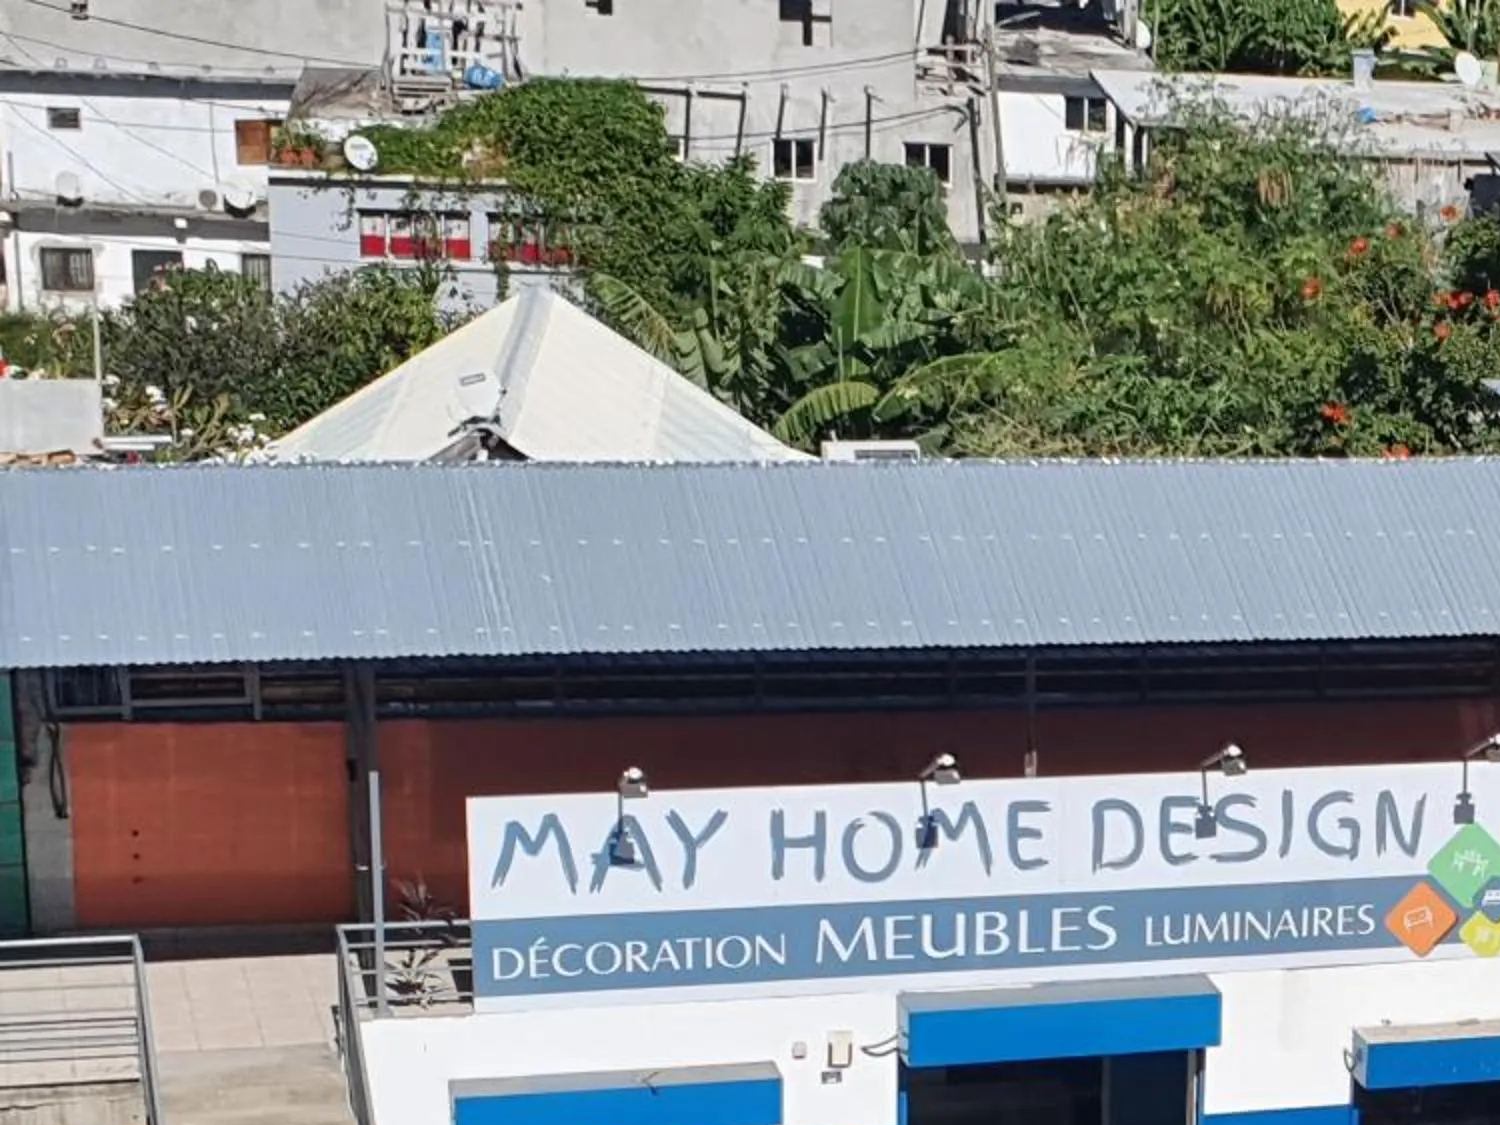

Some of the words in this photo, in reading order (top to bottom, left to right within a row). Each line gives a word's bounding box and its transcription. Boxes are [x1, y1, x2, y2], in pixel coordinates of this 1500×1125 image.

[491, 808, 728, 894] MAY
[769, 799, 1053, 885] HOME
[1090, 788, 1428, 875] DESIGN
[491, 933, 787, 980] DÉCORATION
[815, 904, 1118, 965] MEUBLES
[1144, 902, 1376, 948] LUMINAIRES
